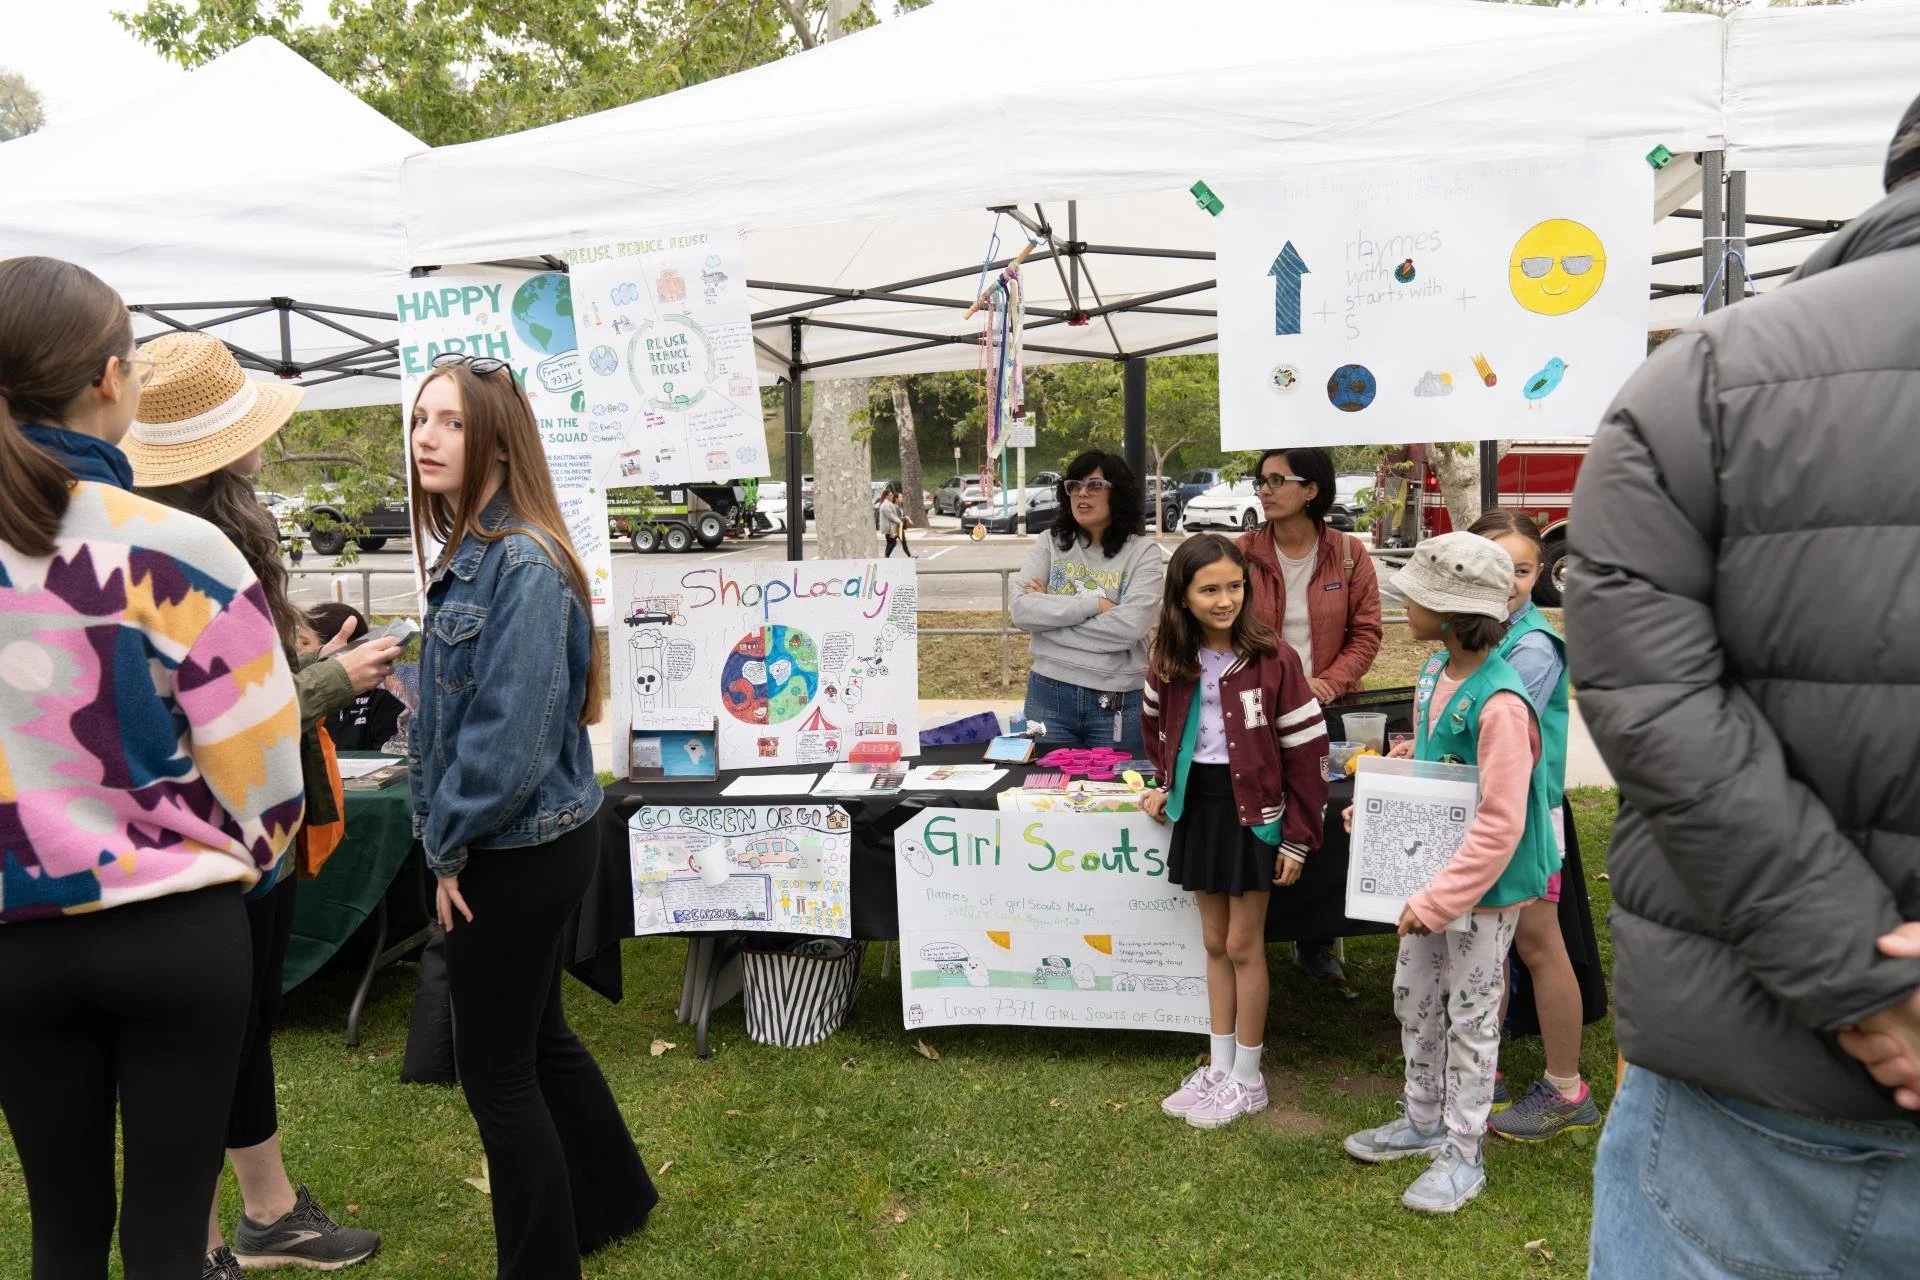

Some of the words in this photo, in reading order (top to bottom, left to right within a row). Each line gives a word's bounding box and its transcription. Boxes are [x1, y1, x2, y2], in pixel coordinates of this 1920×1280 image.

[1345, 228, 1443, 264] rhymes
[1346, 261, 1390, 287] with
[397, 284, 503, 324] HAPPY
[1345, 283, 1404, 311] starts
[1409, 276, 1443, 299] with
[1344, 313, 1360, 341] S
[550, 371, 574, 385] 7371
[557, 417, 579, 428] THE
[548, 432, 588, 443] SQUAD
[639, 807, 671, 831] GO
[679, 807, 757, 833] GREEN
[767, 807, 793, 828] OR
[797, 807, 821, 827] GO
[924, 815, 1001, 867] Girl
[1023, 822, 1168, 877] Scouts
[980, 893, 996, 906] of
[943, 997, 986, 1021] Troop
[992, 997, 1037, 1019] 7371
[1085, 1005, 1128, 1023] SCOUTS
[1132, 1010, 1149, 1023] OF
